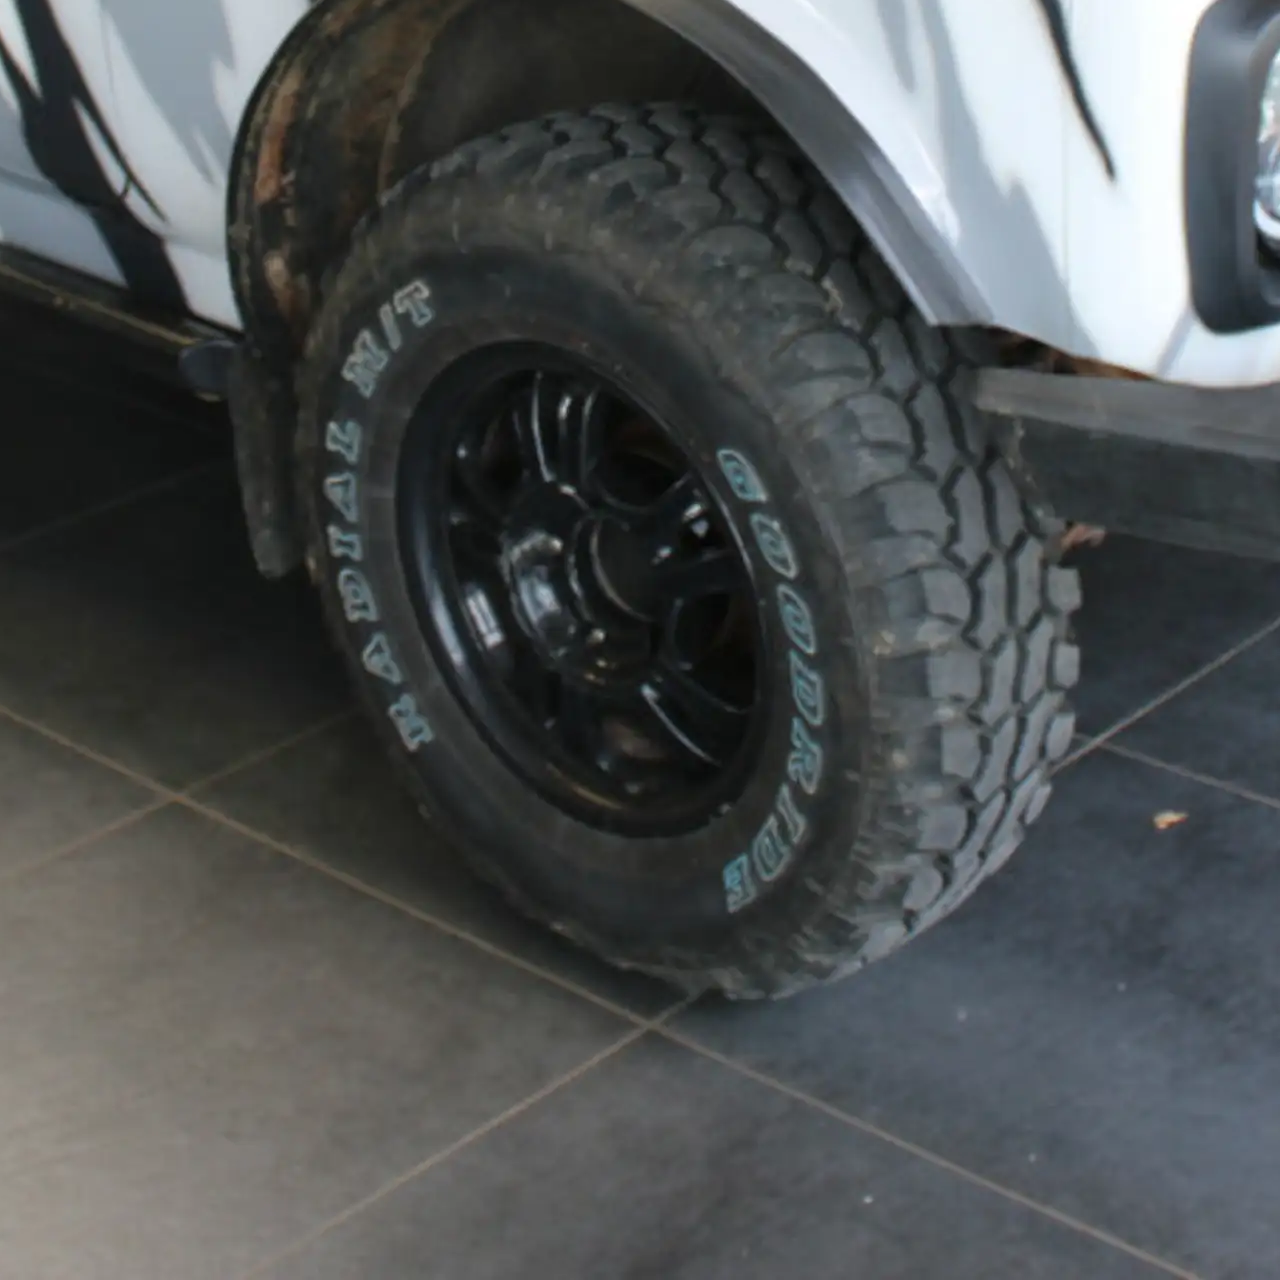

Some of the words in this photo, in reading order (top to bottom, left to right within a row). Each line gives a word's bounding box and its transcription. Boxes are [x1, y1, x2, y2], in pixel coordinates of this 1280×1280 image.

[341, 278, 436, 398] M/T
[323, 420, 435, 752] RADIAL
[717, 449, 826, 913] GOODRIDE
